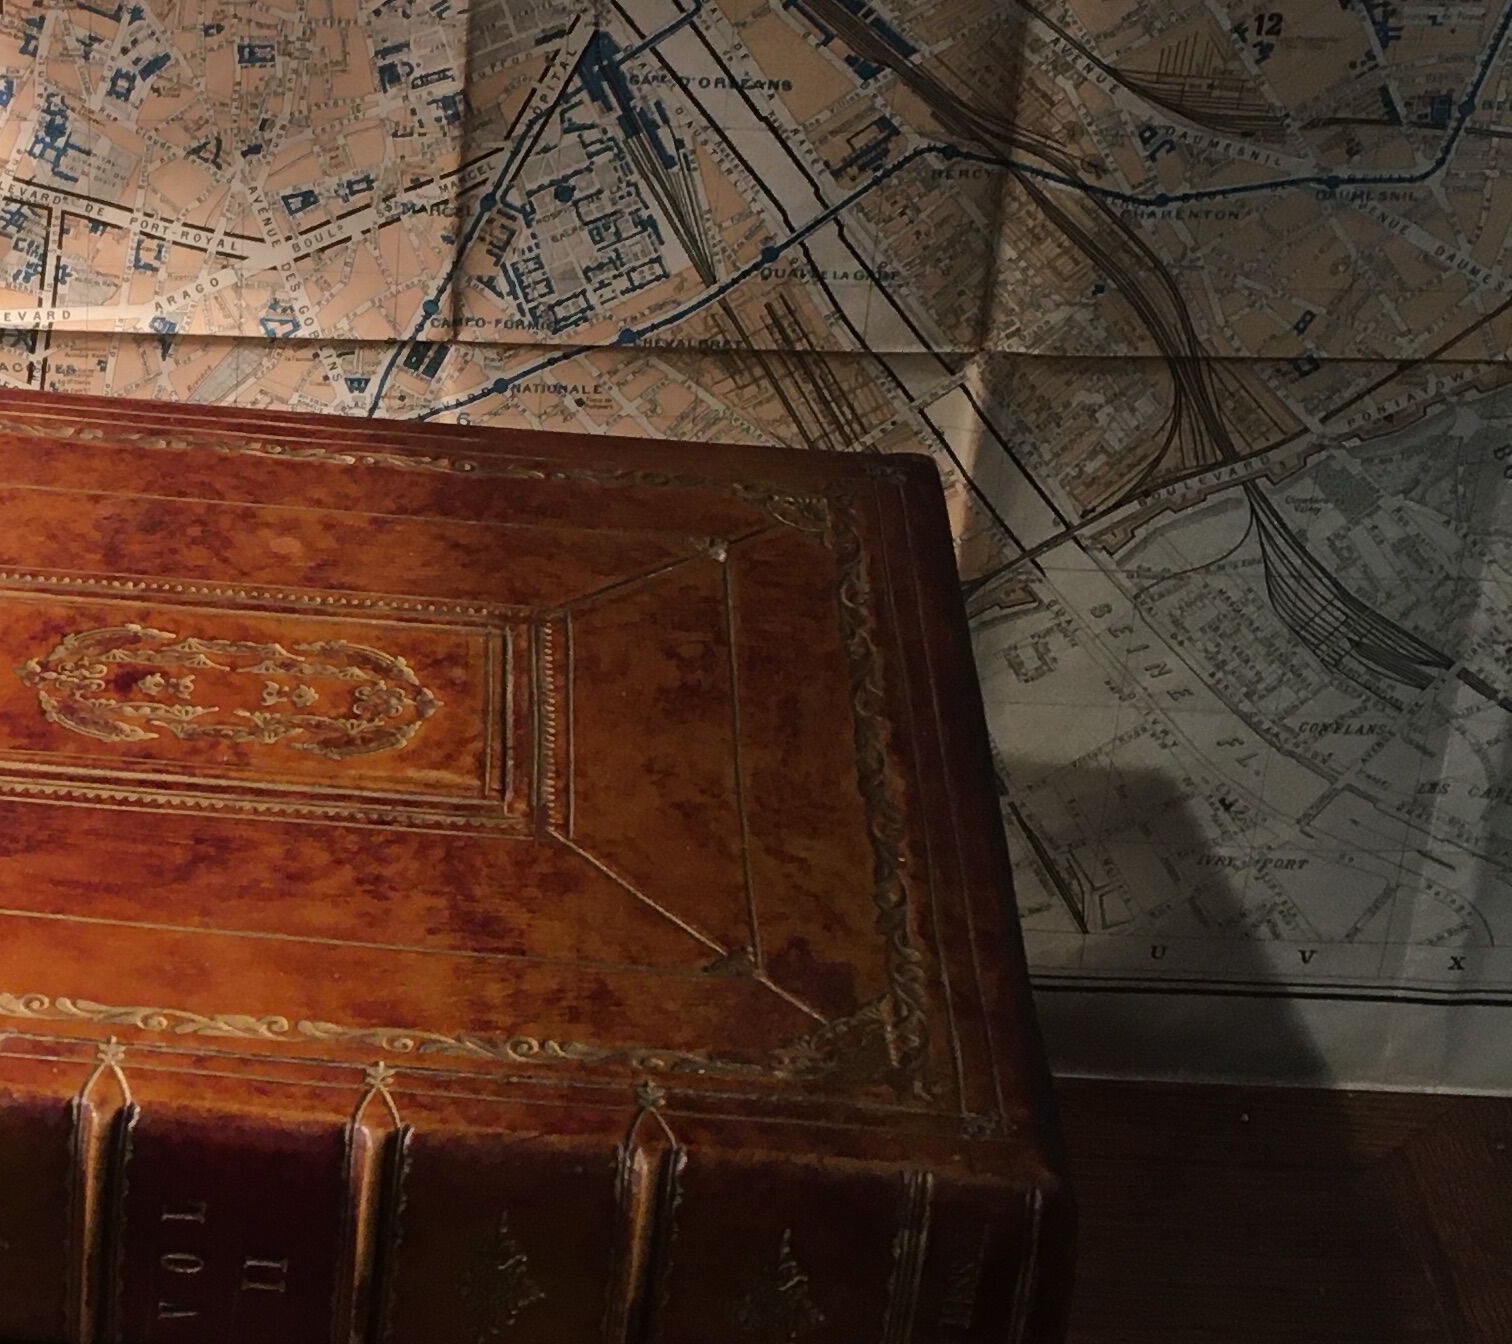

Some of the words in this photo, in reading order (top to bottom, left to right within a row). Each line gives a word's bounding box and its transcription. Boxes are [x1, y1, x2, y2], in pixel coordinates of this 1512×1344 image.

[1253, 13, 1283, 37] 12
[1050, 36, 1122, 95] AVENUE
[84, 203, 104, 218] DE
[248, 186, 281, 248] AVENUE
[154, 276, 220, 311] ARAGO
[1150, 945, 1168, 960] U
[1299, 949, 1318, 965] V
[1448, 955, 1466, 971] X
[157, 1198, 209, 1320] VOL
[240, 1254, 289, 1294] II
